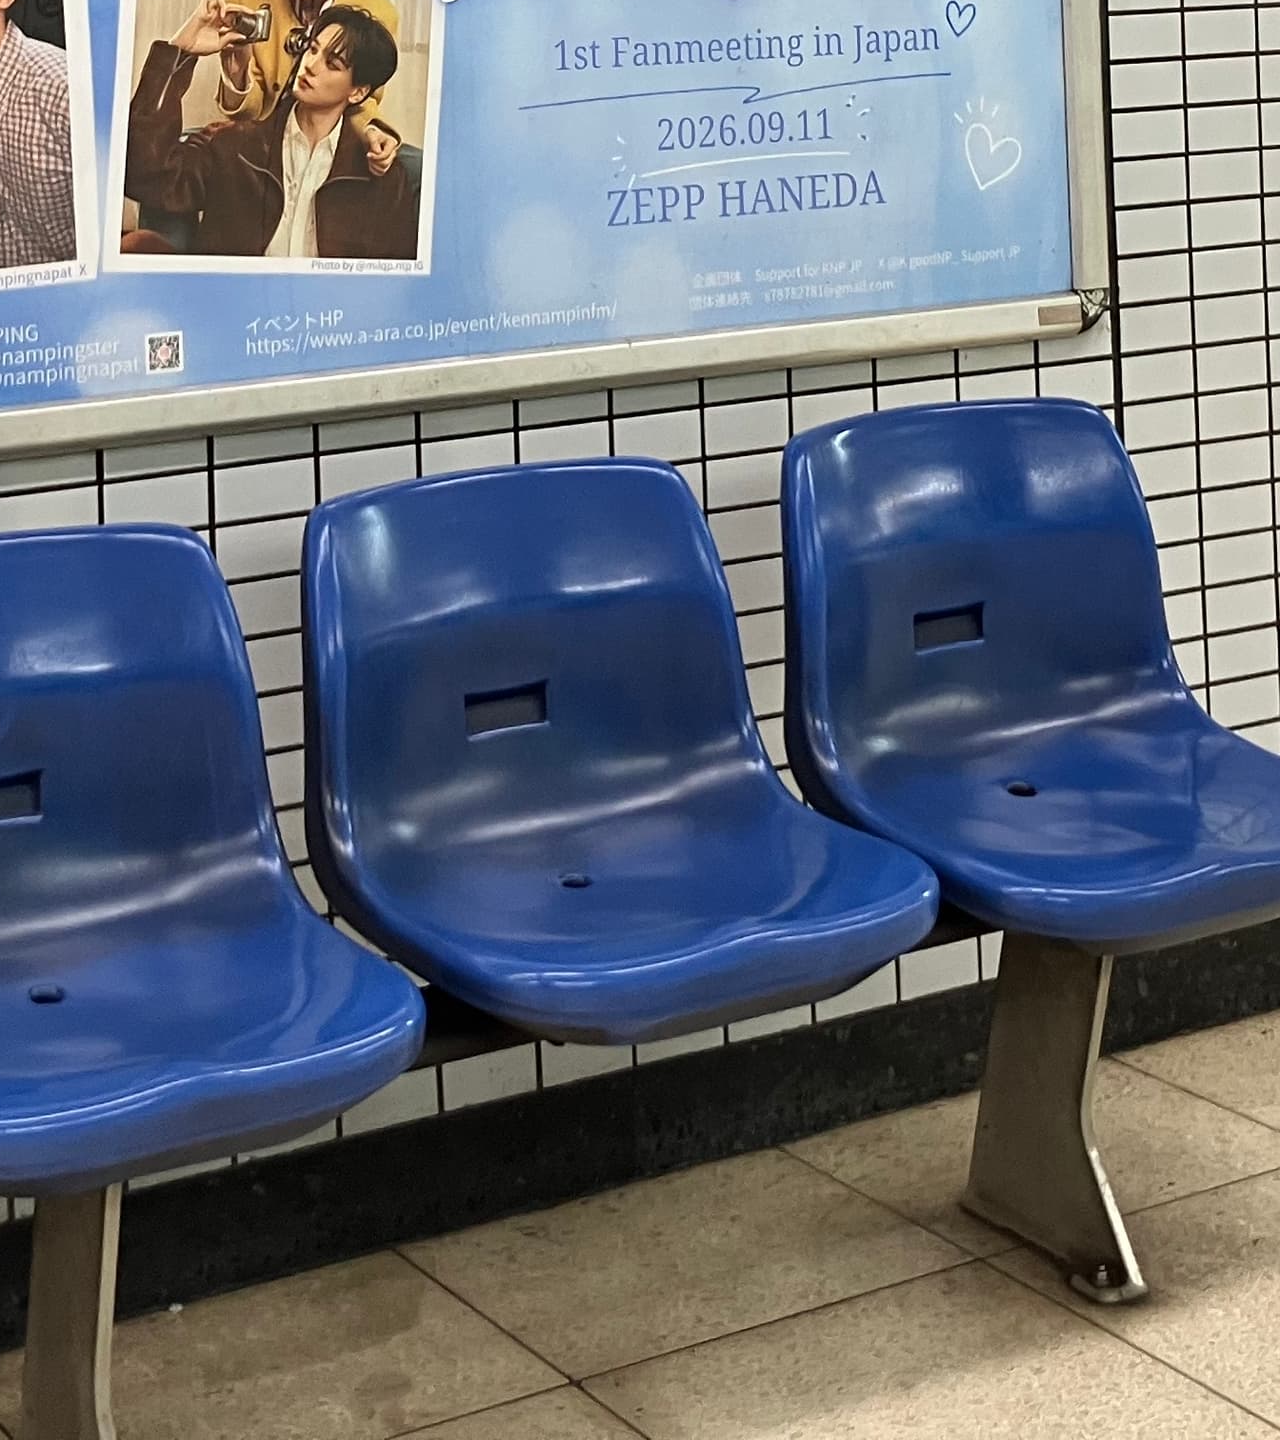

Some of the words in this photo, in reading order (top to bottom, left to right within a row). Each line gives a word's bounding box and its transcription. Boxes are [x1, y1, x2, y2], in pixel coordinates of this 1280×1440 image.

[554, 39, 601, 71] 1st
[612, 29, 804, 66] Fanmeeting
[813, 26, 845, 57] in
[852, 24, 940, 64] Japan
[657, 107, 834, 152] 2026.09.11
[606, 183, 705, 227] ZEPP
[718, 169, 887, 218] HANEDA
[78, 263, 88, 277] X
[311, 260, 340, 270] Photo
[342, 261, 354, 272] by
[245, 309, 344, 333] イベントHP
